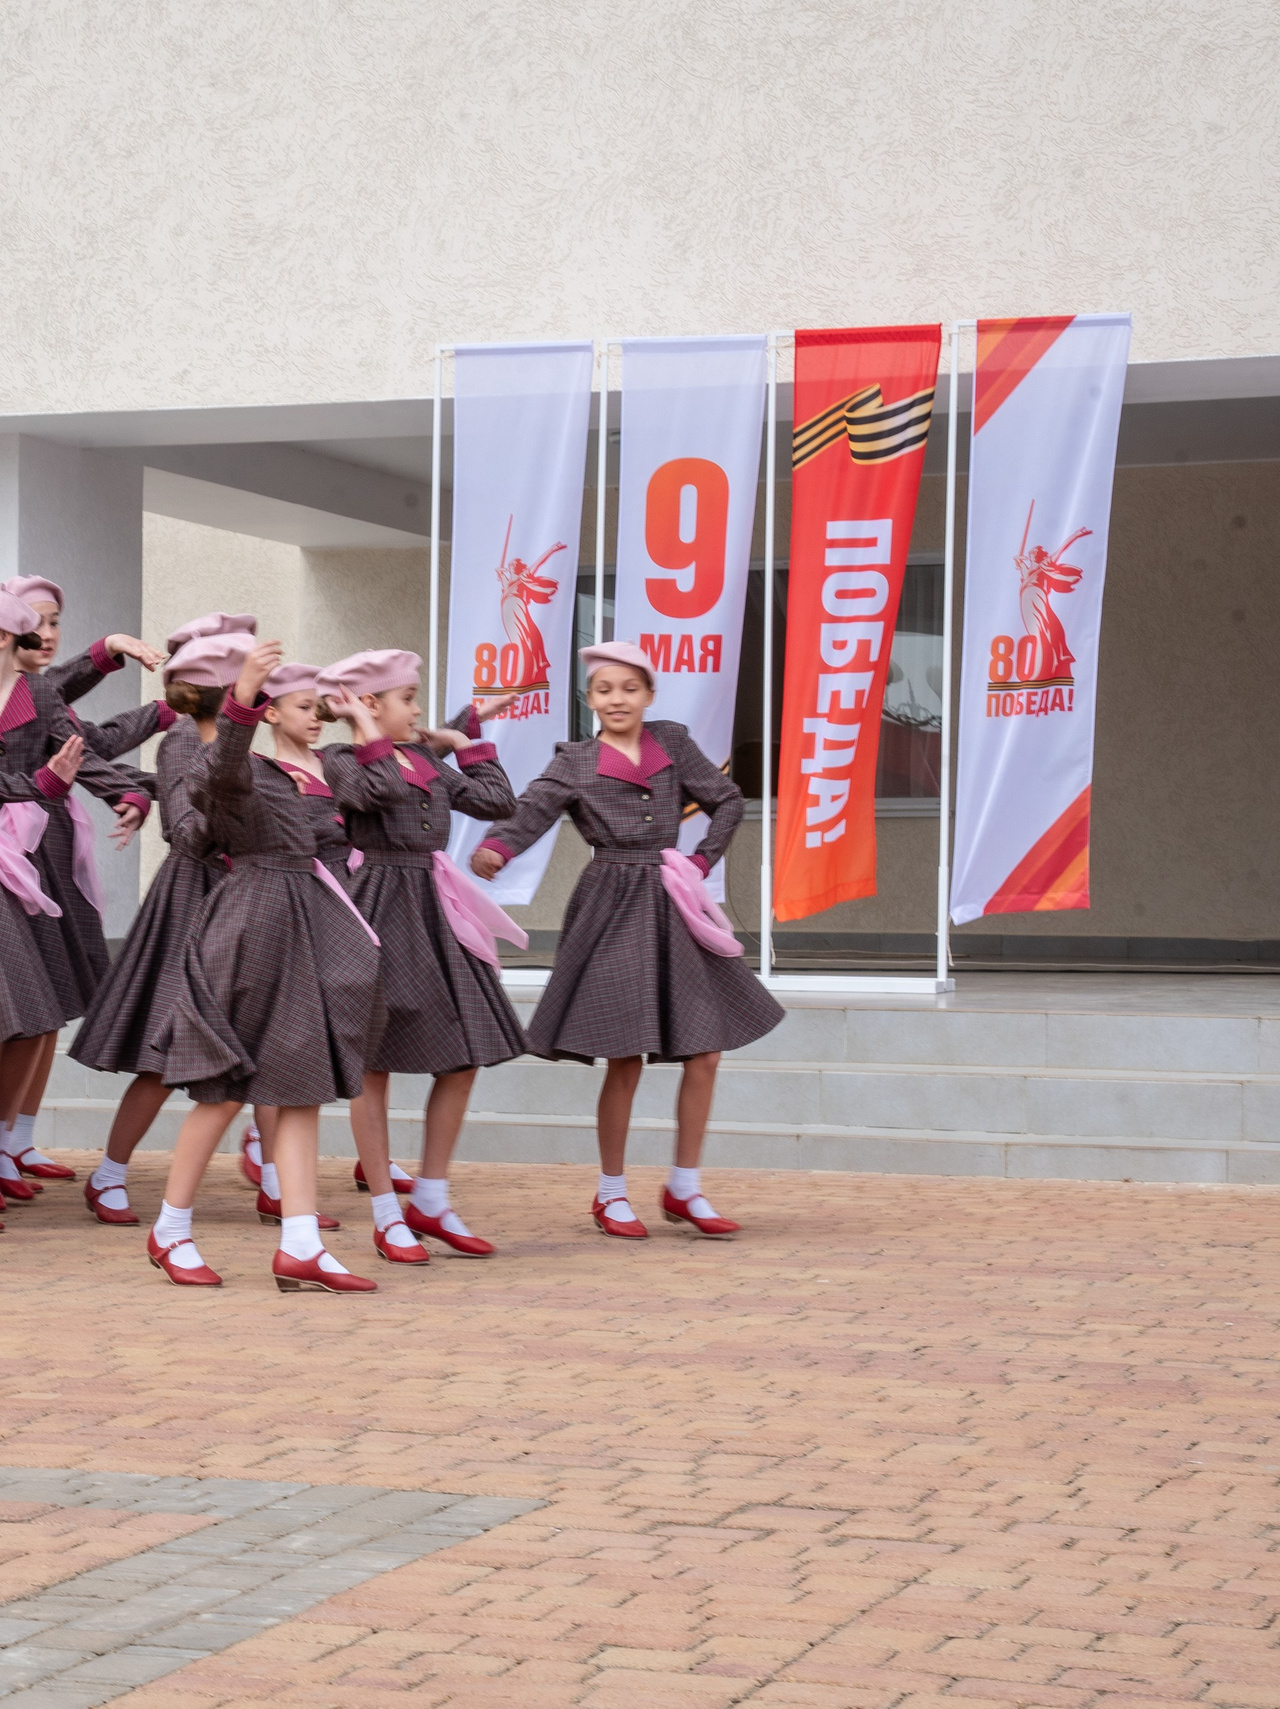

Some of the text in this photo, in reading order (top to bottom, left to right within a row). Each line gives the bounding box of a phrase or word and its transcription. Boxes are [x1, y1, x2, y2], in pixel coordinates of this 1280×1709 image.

[645, 457, 729, 618] 9
[473, 642, 520, 688] 80
[640, 633, 723, 673] МАЯ
[988, 634, 1038, 682] 80
[472, 692, 550, 721] ПЕДА!
[801, 519, 892, 848] ПОБЕДА!
[986, 688, 1074, 717] ПОБЕДА!
